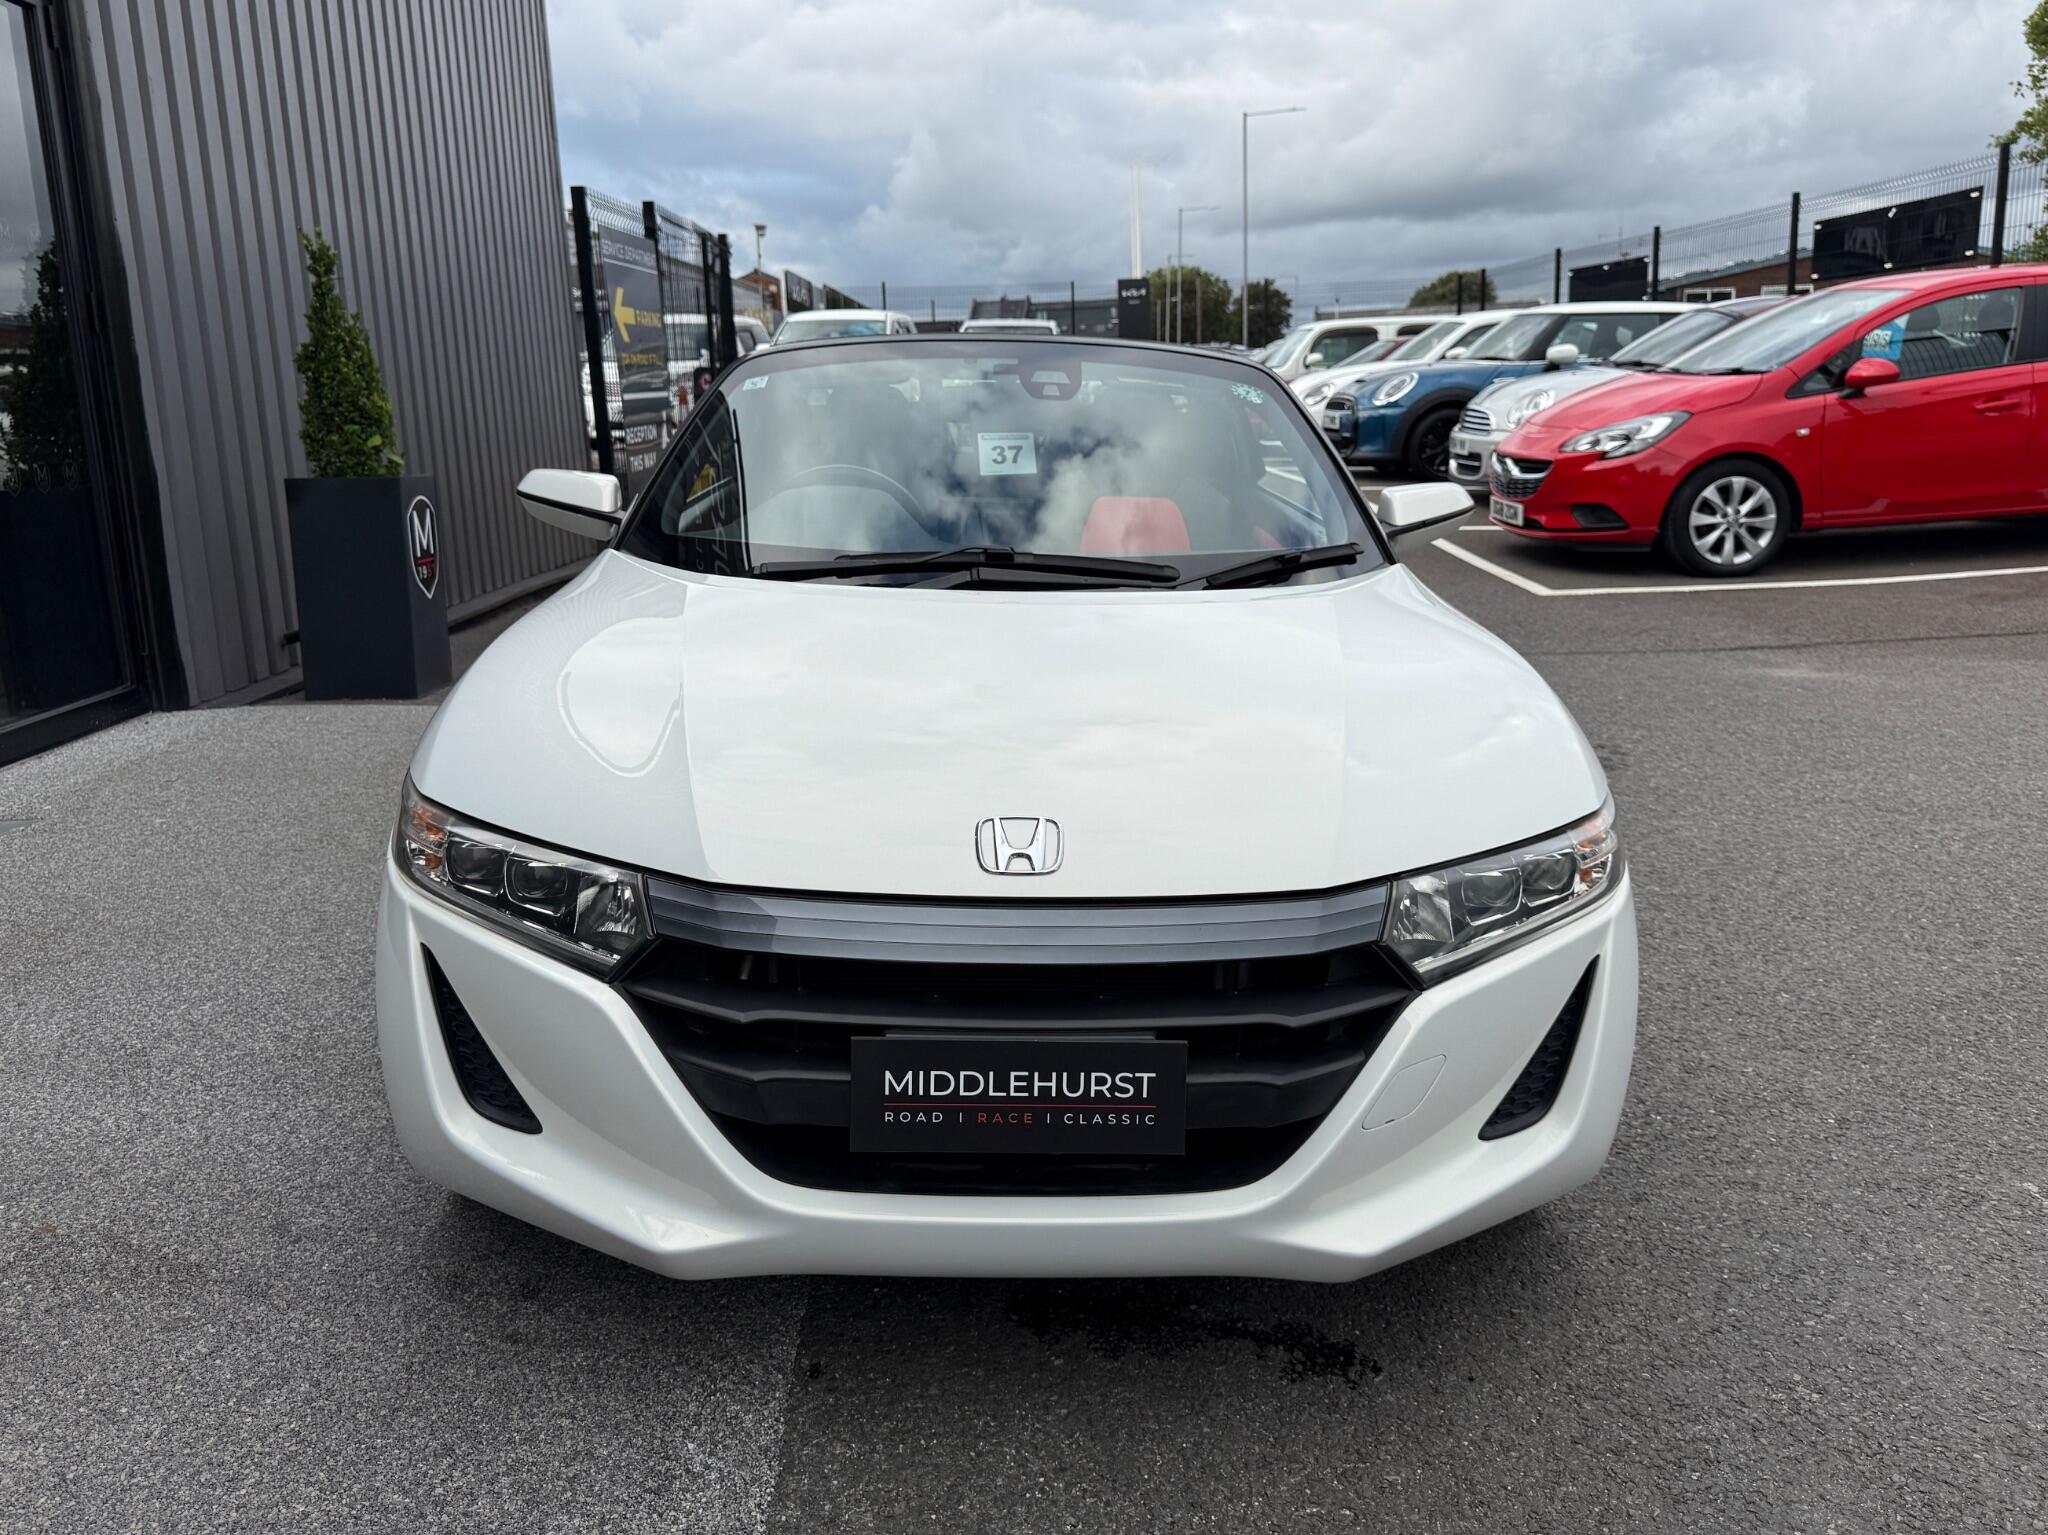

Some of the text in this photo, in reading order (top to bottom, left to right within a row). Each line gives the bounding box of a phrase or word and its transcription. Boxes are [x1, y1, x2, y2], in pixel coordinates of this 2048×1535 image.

[626, 424, 658, 444] RECEPTION
[630, 454, 644, 472] THIS
[991, 445, 1023, 464] 37
[412, 508, 434, 557] M
[884, 1070, 1156, 1098] MIDDLEHURST
[884, 1111, 943, 1123] ROAD
[977, 1112, 1033, 1124] RACE
[1063, 1113, 1155, 1125] CLASSIC
